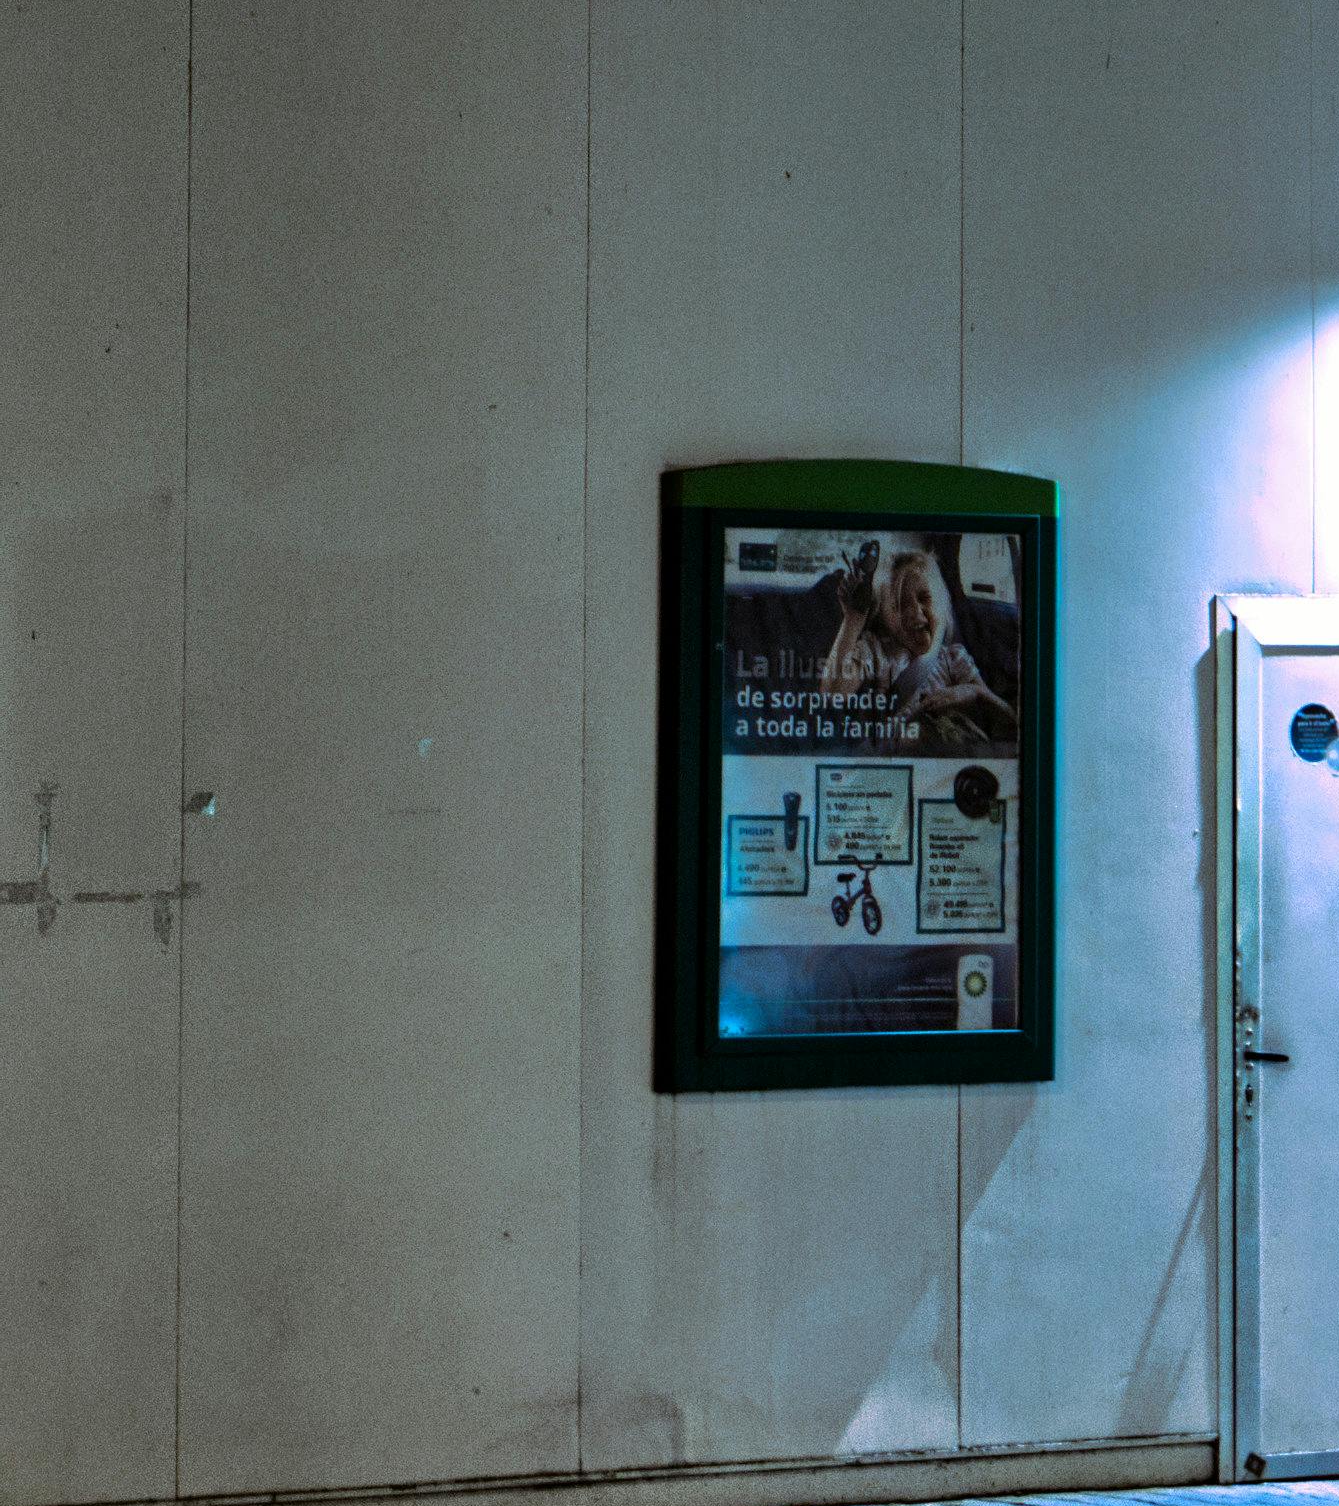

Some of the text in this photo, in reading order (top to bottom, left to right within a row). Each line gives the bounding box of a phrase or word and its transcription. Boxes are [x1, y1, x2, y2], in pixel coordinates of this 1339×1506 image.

[737, 649, 769, 678] La
[737, 685, 898, 715] de sorprender
[735, 714, 921, 739] a toda la familia
[736, 827, 774, 836] PHILIPS
